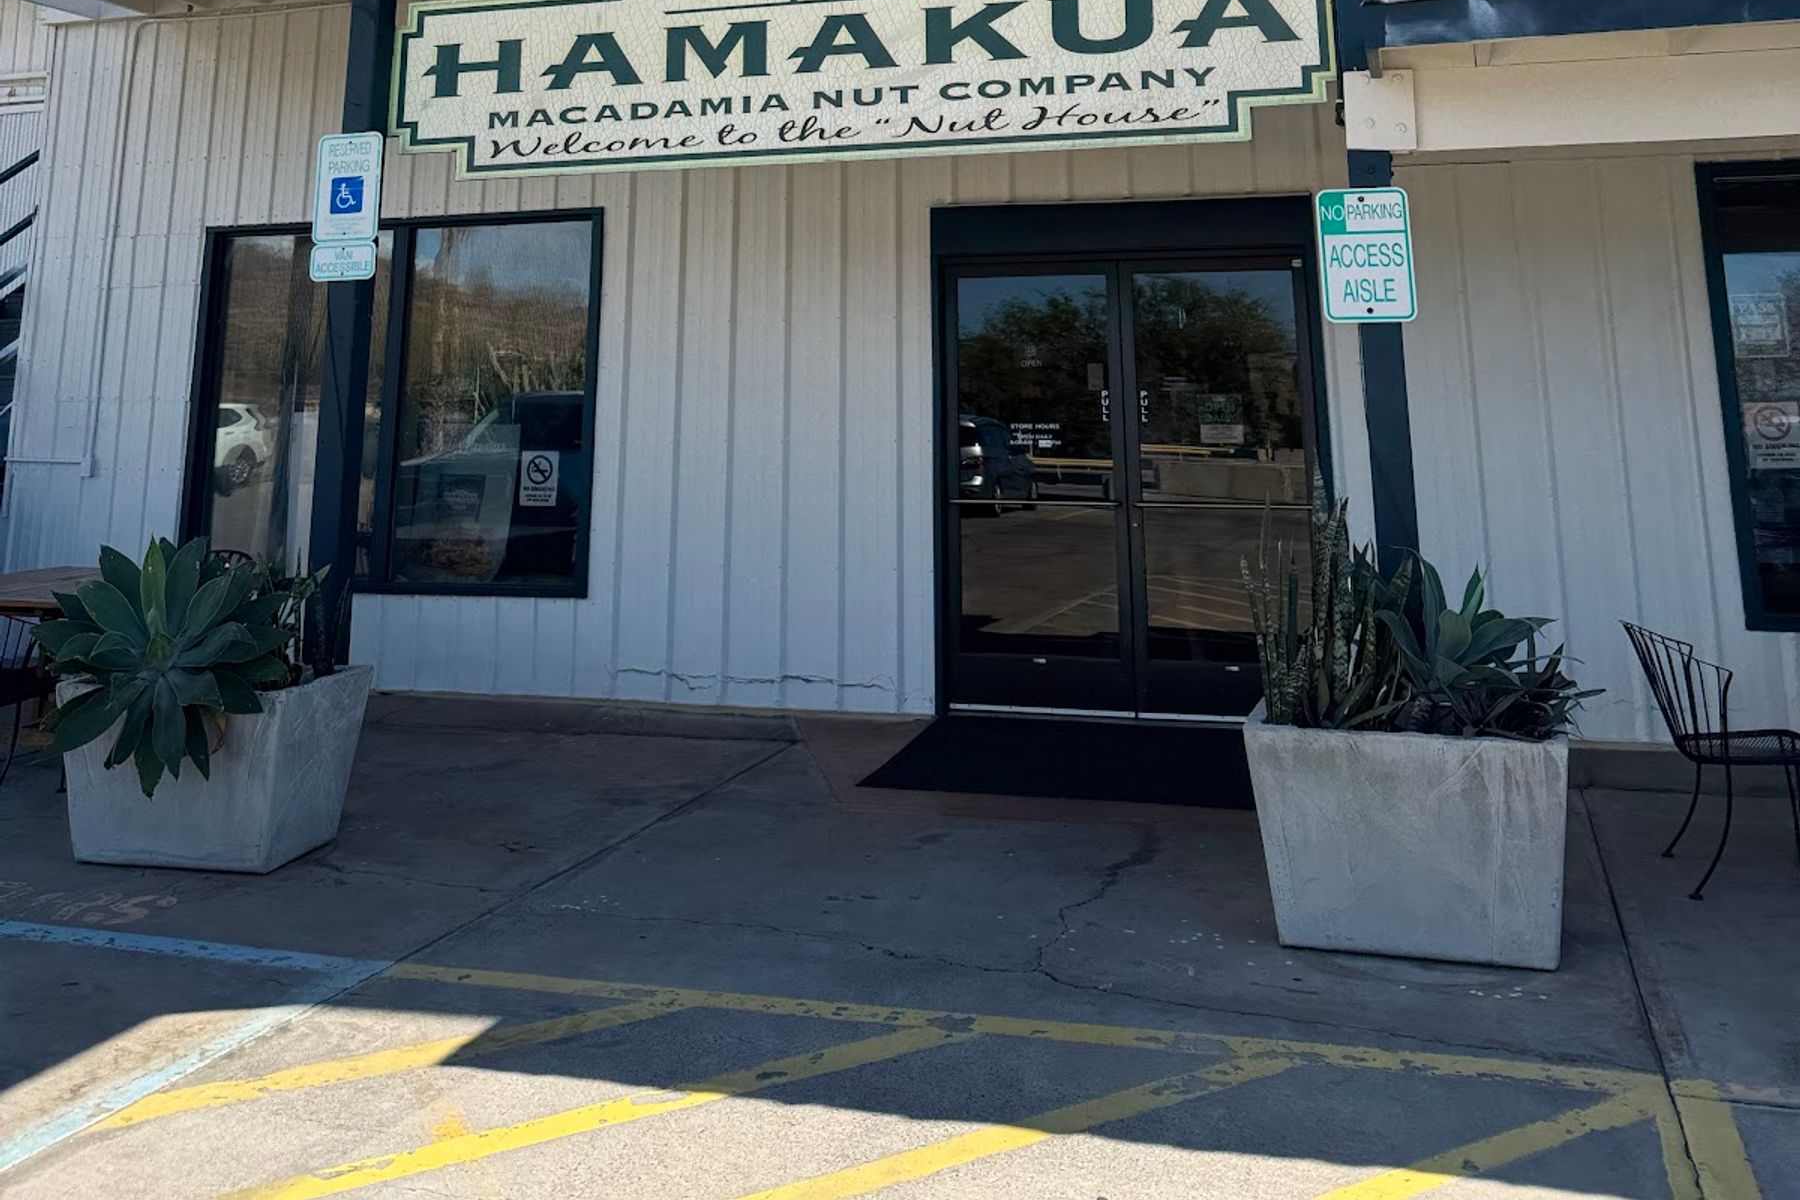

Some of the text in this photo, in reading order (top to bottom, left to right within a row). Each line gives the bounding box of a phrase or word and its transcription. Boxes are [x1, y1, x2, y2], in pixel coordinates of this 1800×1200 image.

[488, 66, 1217, 130] MACADAMIA NUT COMPANY
[328, 141, 372, 158] RESERVED
[490, 129, 705, 160] Welcome
[717, 123, 759, 146] to
[777, 115, 861, 143] the
[328, 158, 371, 174] PARKING
[1320, 202, 1403, 222] NO PARKING
[334, 249, 355, 261] VAN
[1329, 241, 1405, 268] ACCESS
[315, 260, 371, 275] ACCESSIBLE
[1343, 278, 1397, 303] AISLE
[1101, 390, 1110, 422] PULL
[1139, 390, 1149, 423] PULL
